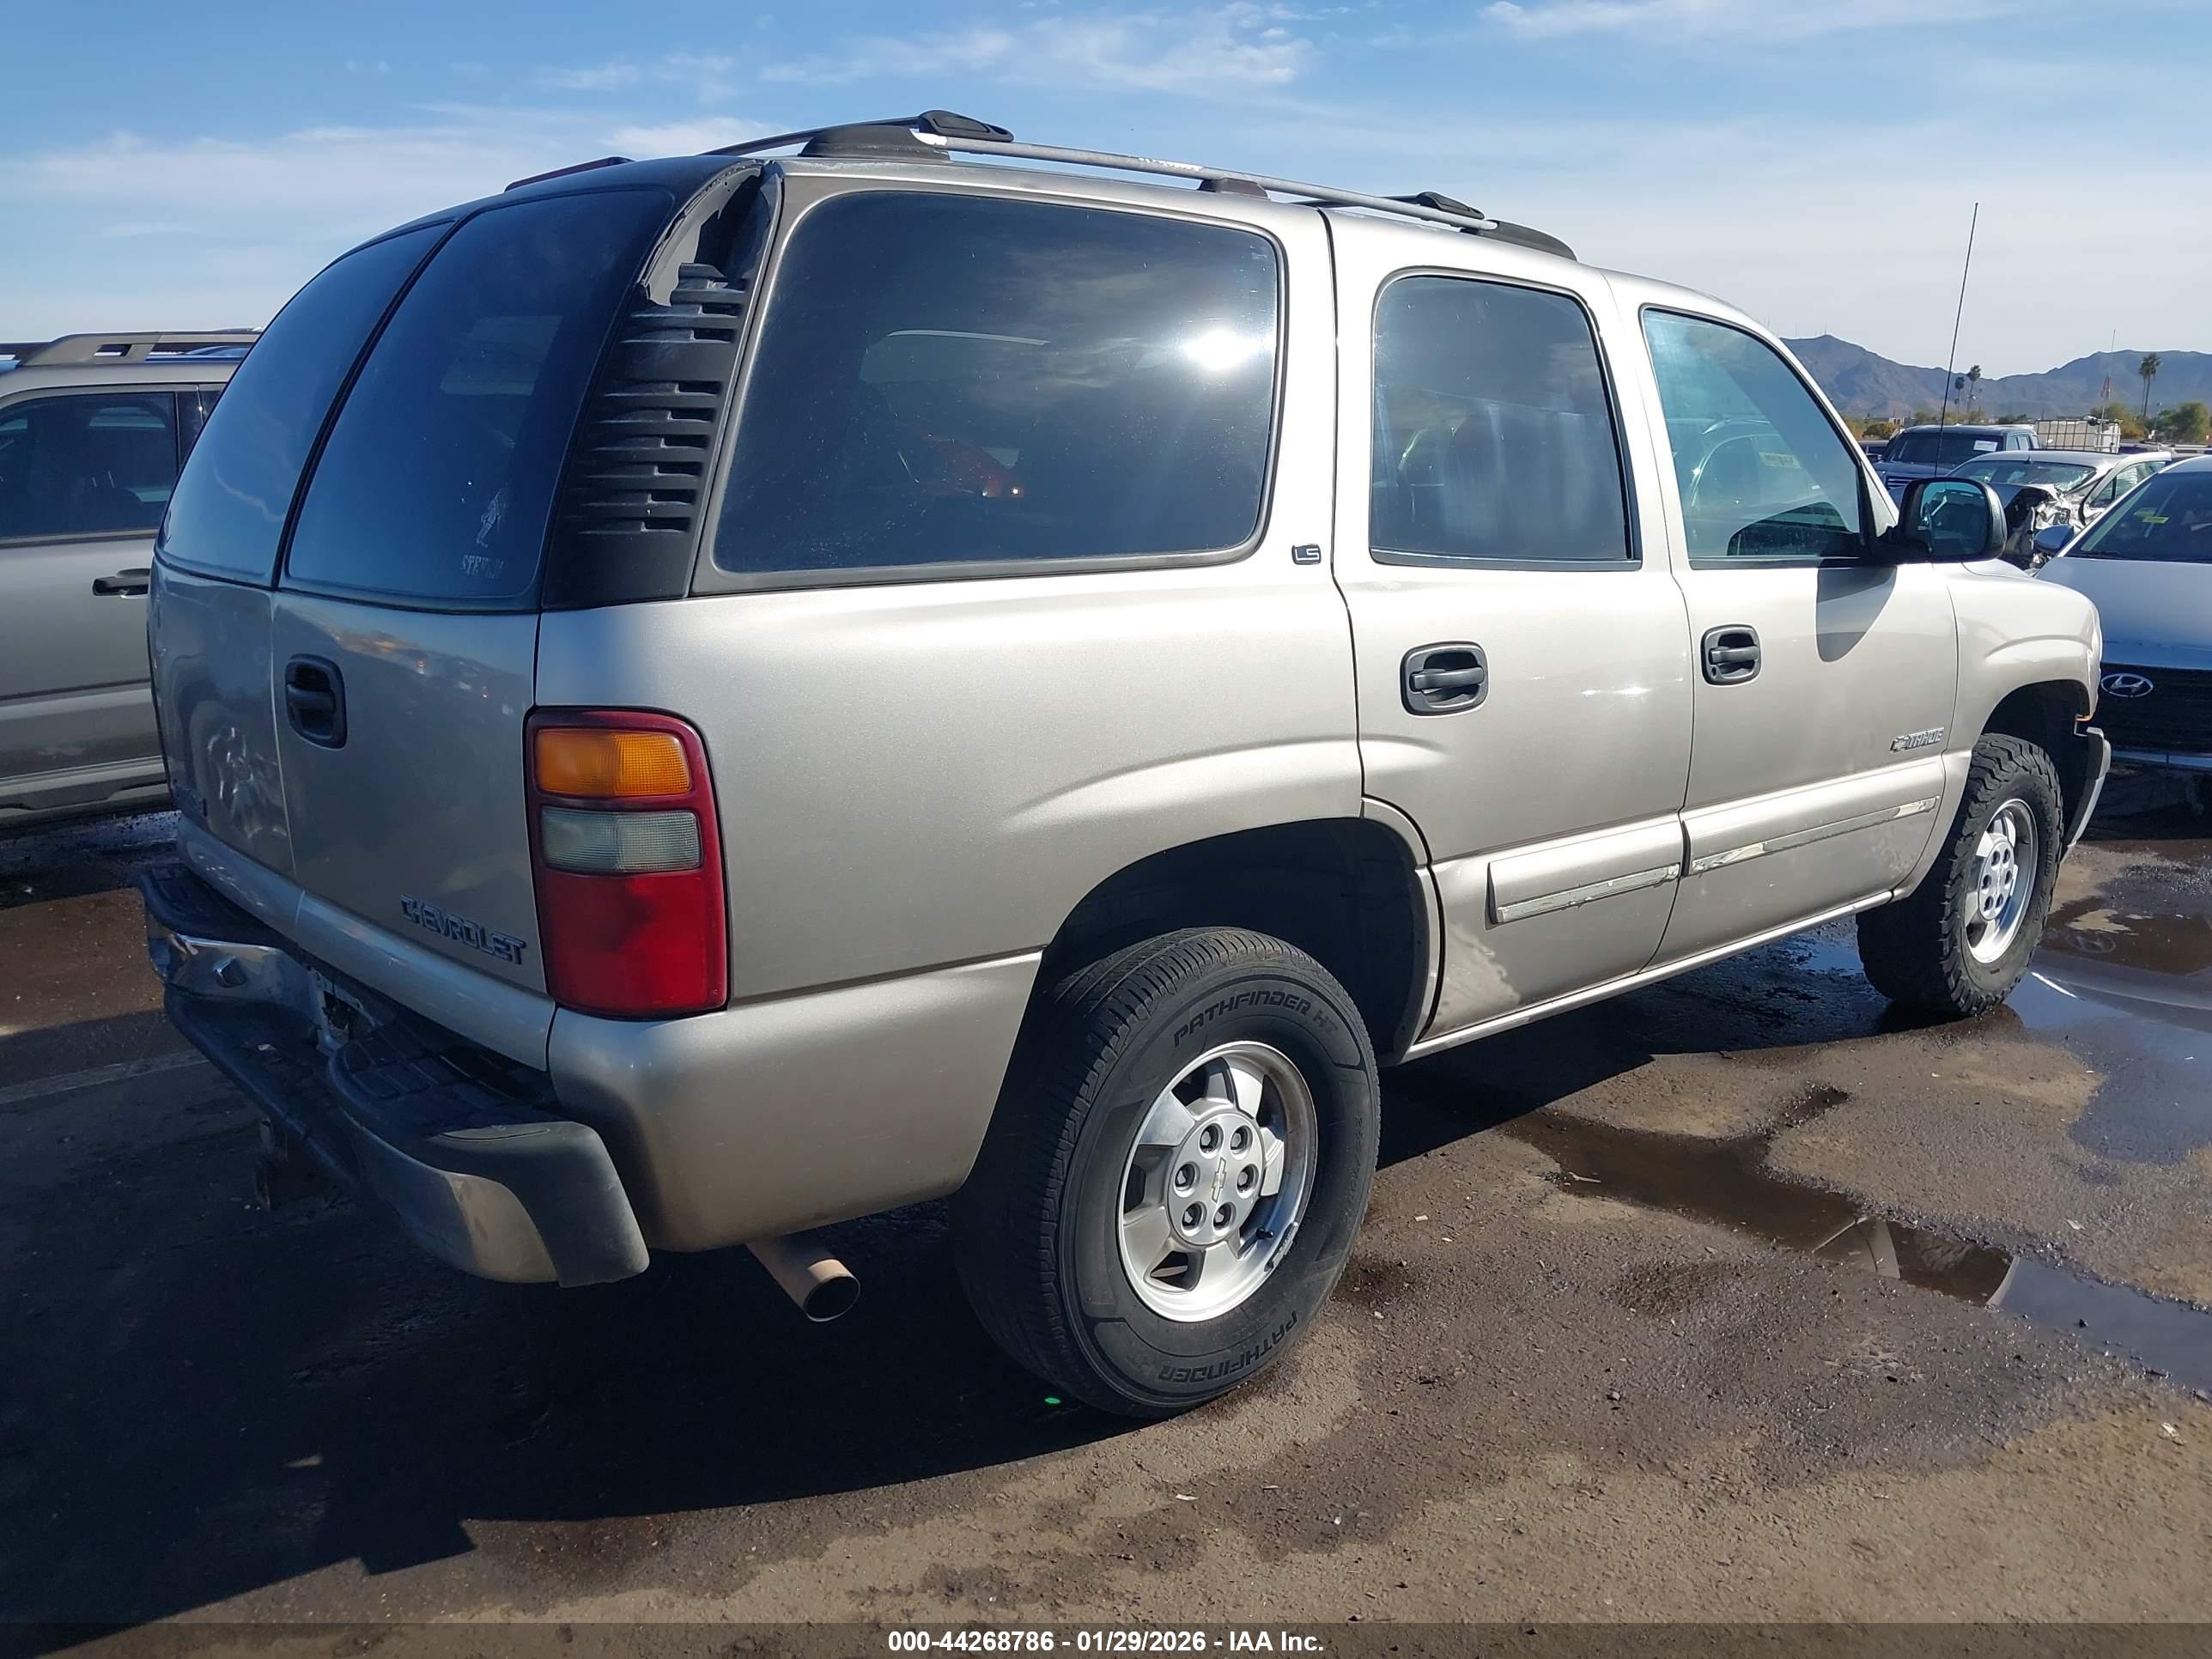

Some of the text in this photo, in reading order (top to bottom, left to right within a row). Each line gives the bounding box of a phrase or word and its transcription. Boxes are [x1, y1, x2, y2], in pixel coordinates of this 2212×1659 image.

[1291, 544, 1322, 565] LS
[399, 893, 527, 966] CHEVROLET
[1173, 989, 1312, 1048] PATHFINDER
[1158, 1310, 1298, 1383] PATHFINDER
